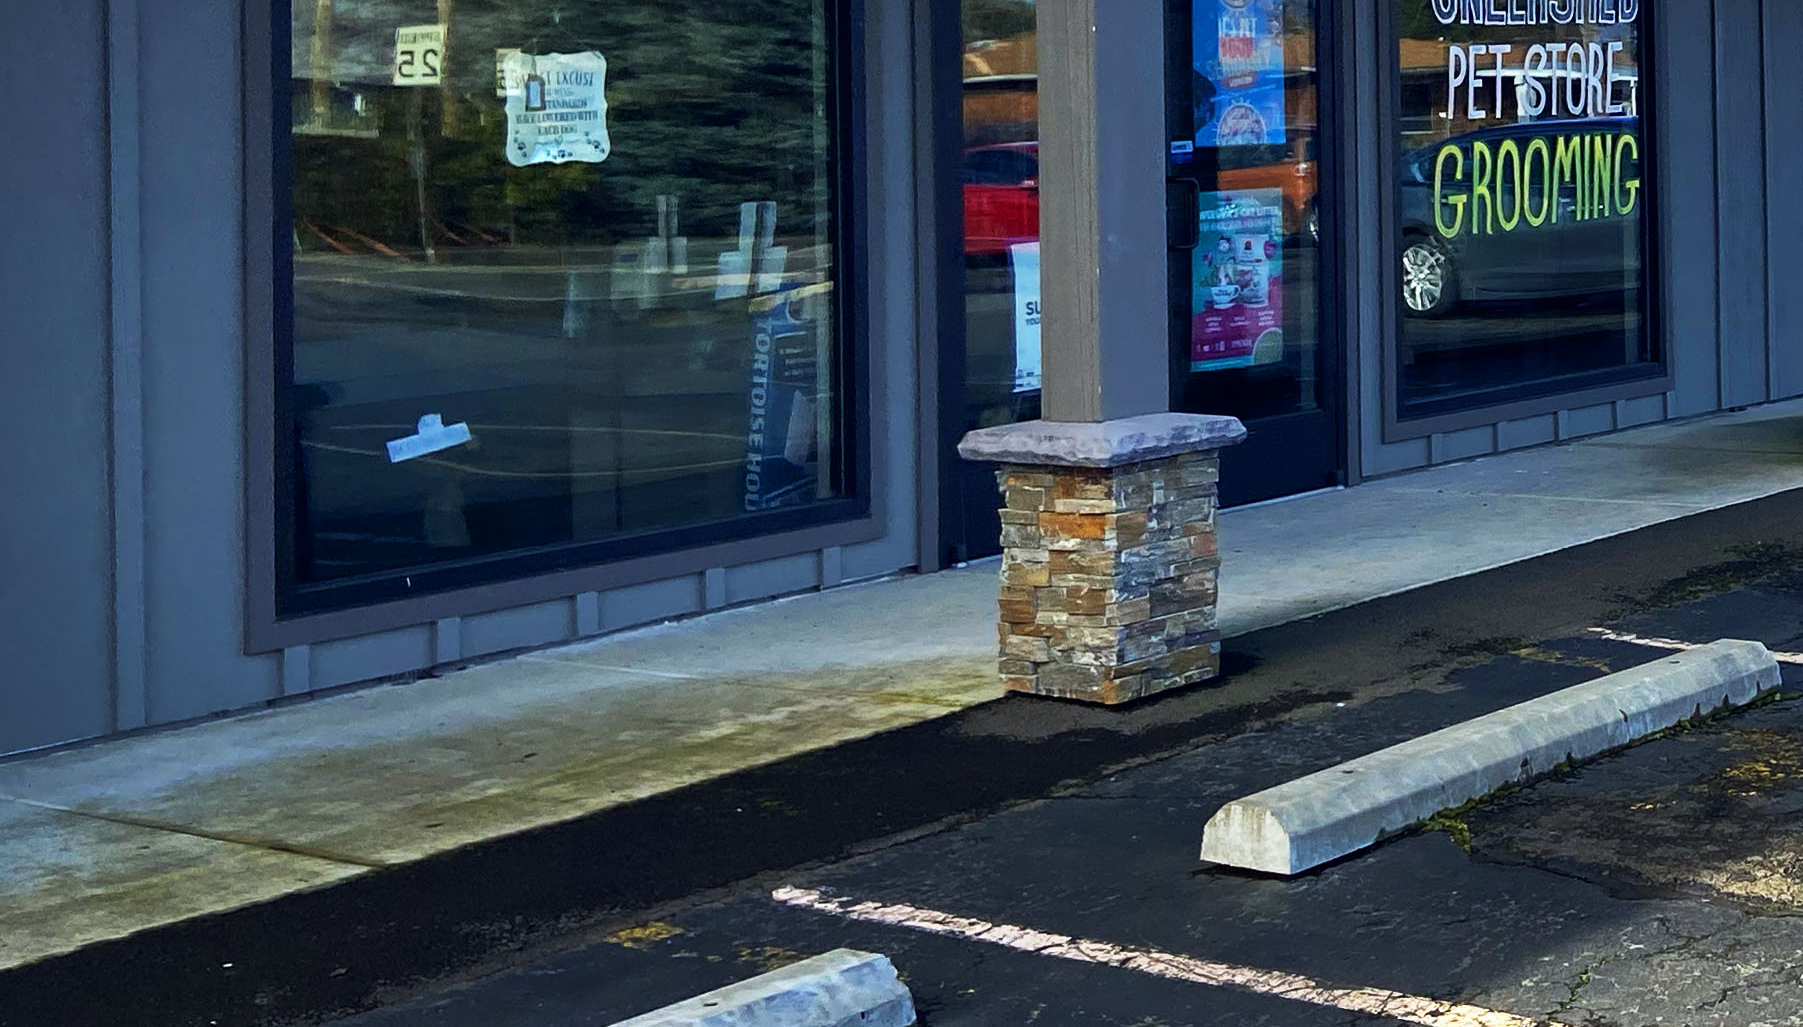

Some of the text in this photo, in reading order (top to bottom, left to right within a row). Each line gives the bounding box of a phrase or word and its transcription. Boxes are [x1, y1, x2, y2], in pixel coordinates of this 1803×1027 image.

[1448, 42, 1626, 120] PET STORE
[1434, 134, 1640, 239] GROOMING
[745, 317, 772, 512] TORTOISE HOU
